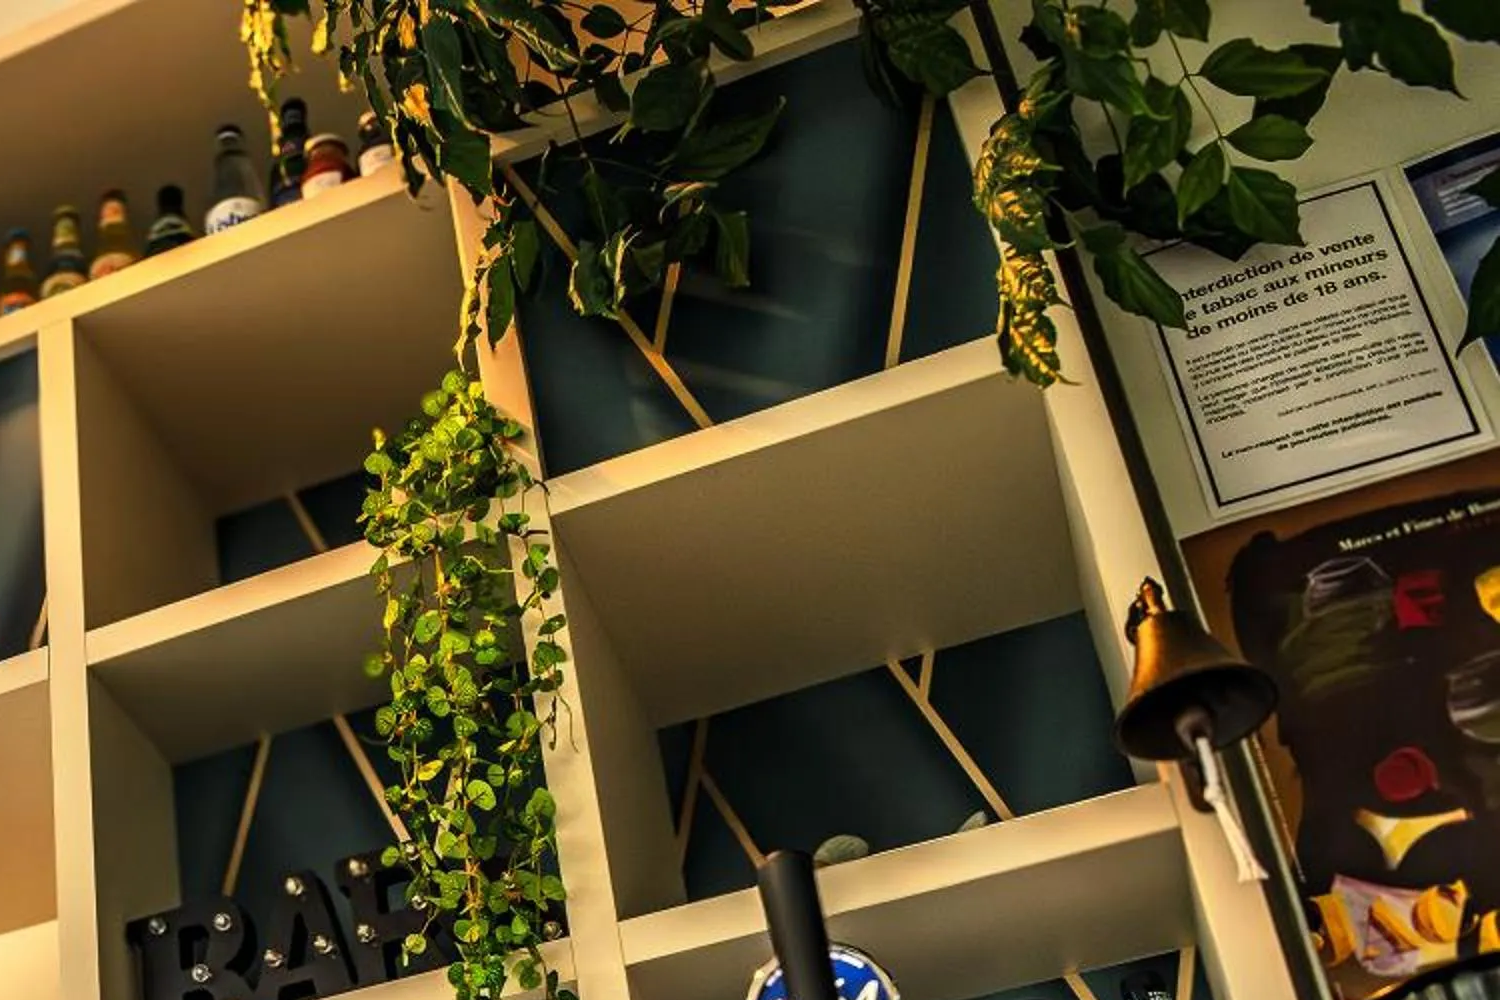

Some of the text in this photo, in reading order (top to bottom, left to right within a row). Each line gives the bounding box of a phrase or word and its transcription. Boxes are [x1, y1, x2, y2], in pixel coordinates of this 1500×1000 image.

[1179, 233, 1375, 301] nterdiction de vente
[1185, 249, 1389, 321] e tabac aux mineurs
[1187, 270, 1388, 340] de moins de 18 ans.
